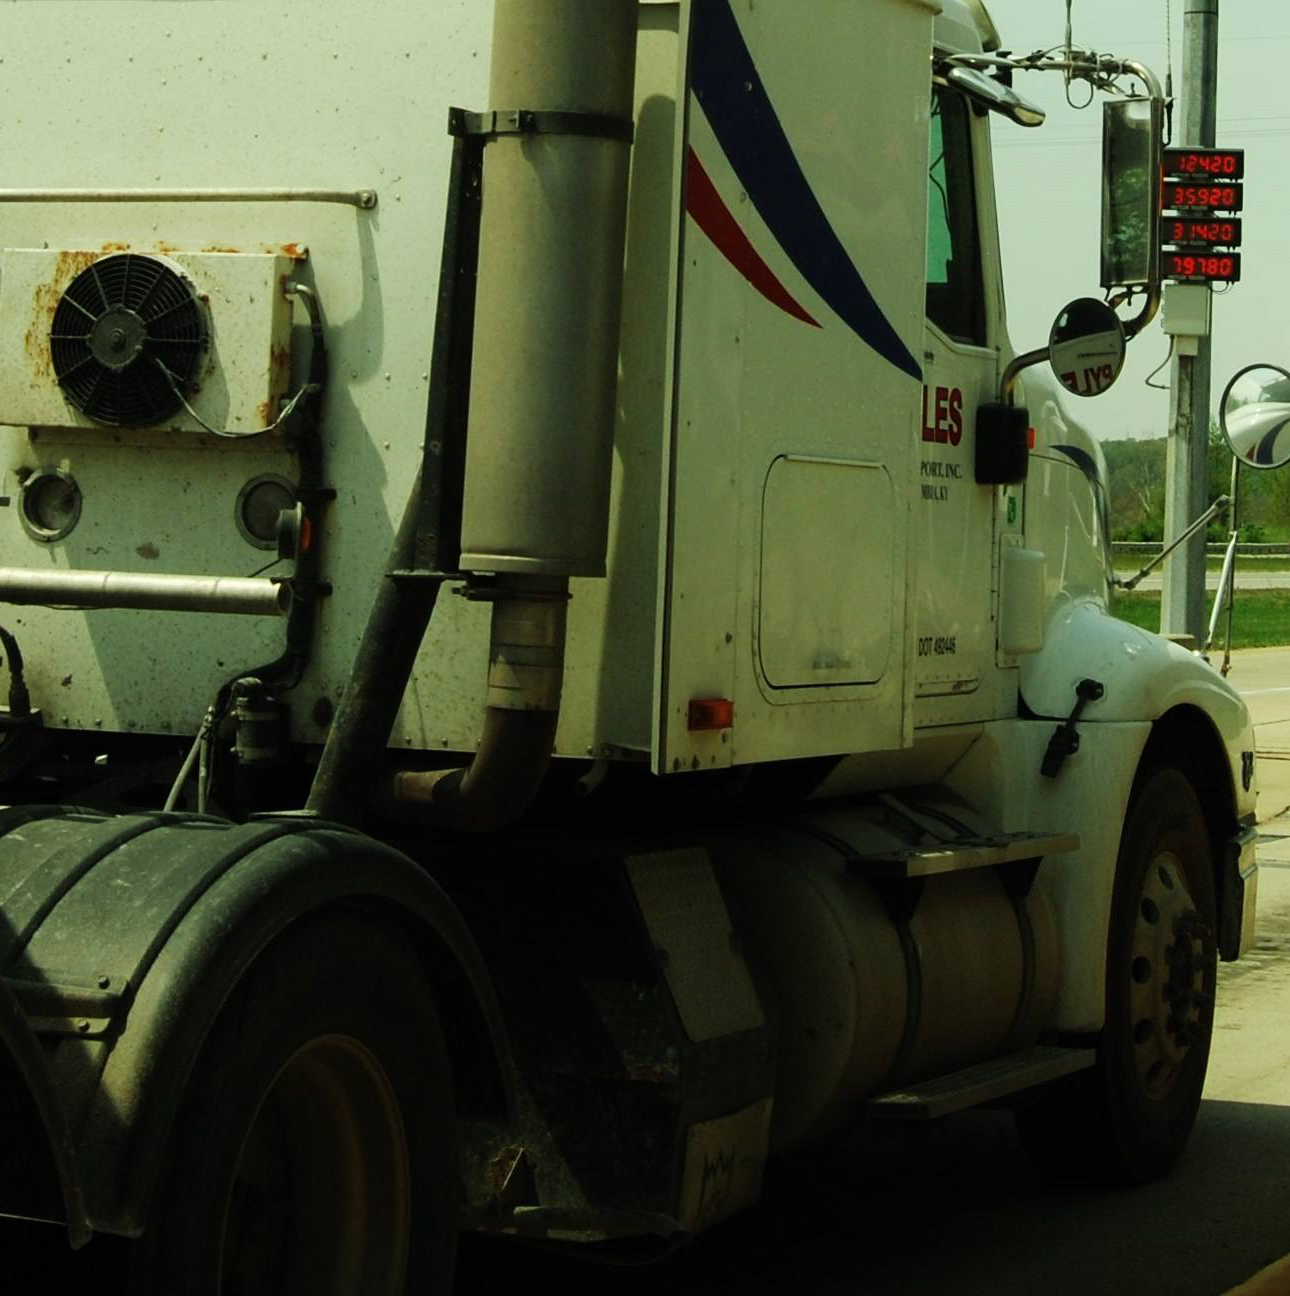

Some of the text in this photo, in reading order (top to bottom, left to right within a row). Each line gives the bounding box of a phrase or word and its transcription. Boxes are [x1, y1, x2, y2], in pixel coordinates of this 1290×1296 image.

[1180, 154, 1235, 173] 12420
[1174, 187, 1234, 206] 35920
[921, 384, 963, 446] LES
[918, 637, 933, 656] DOT
